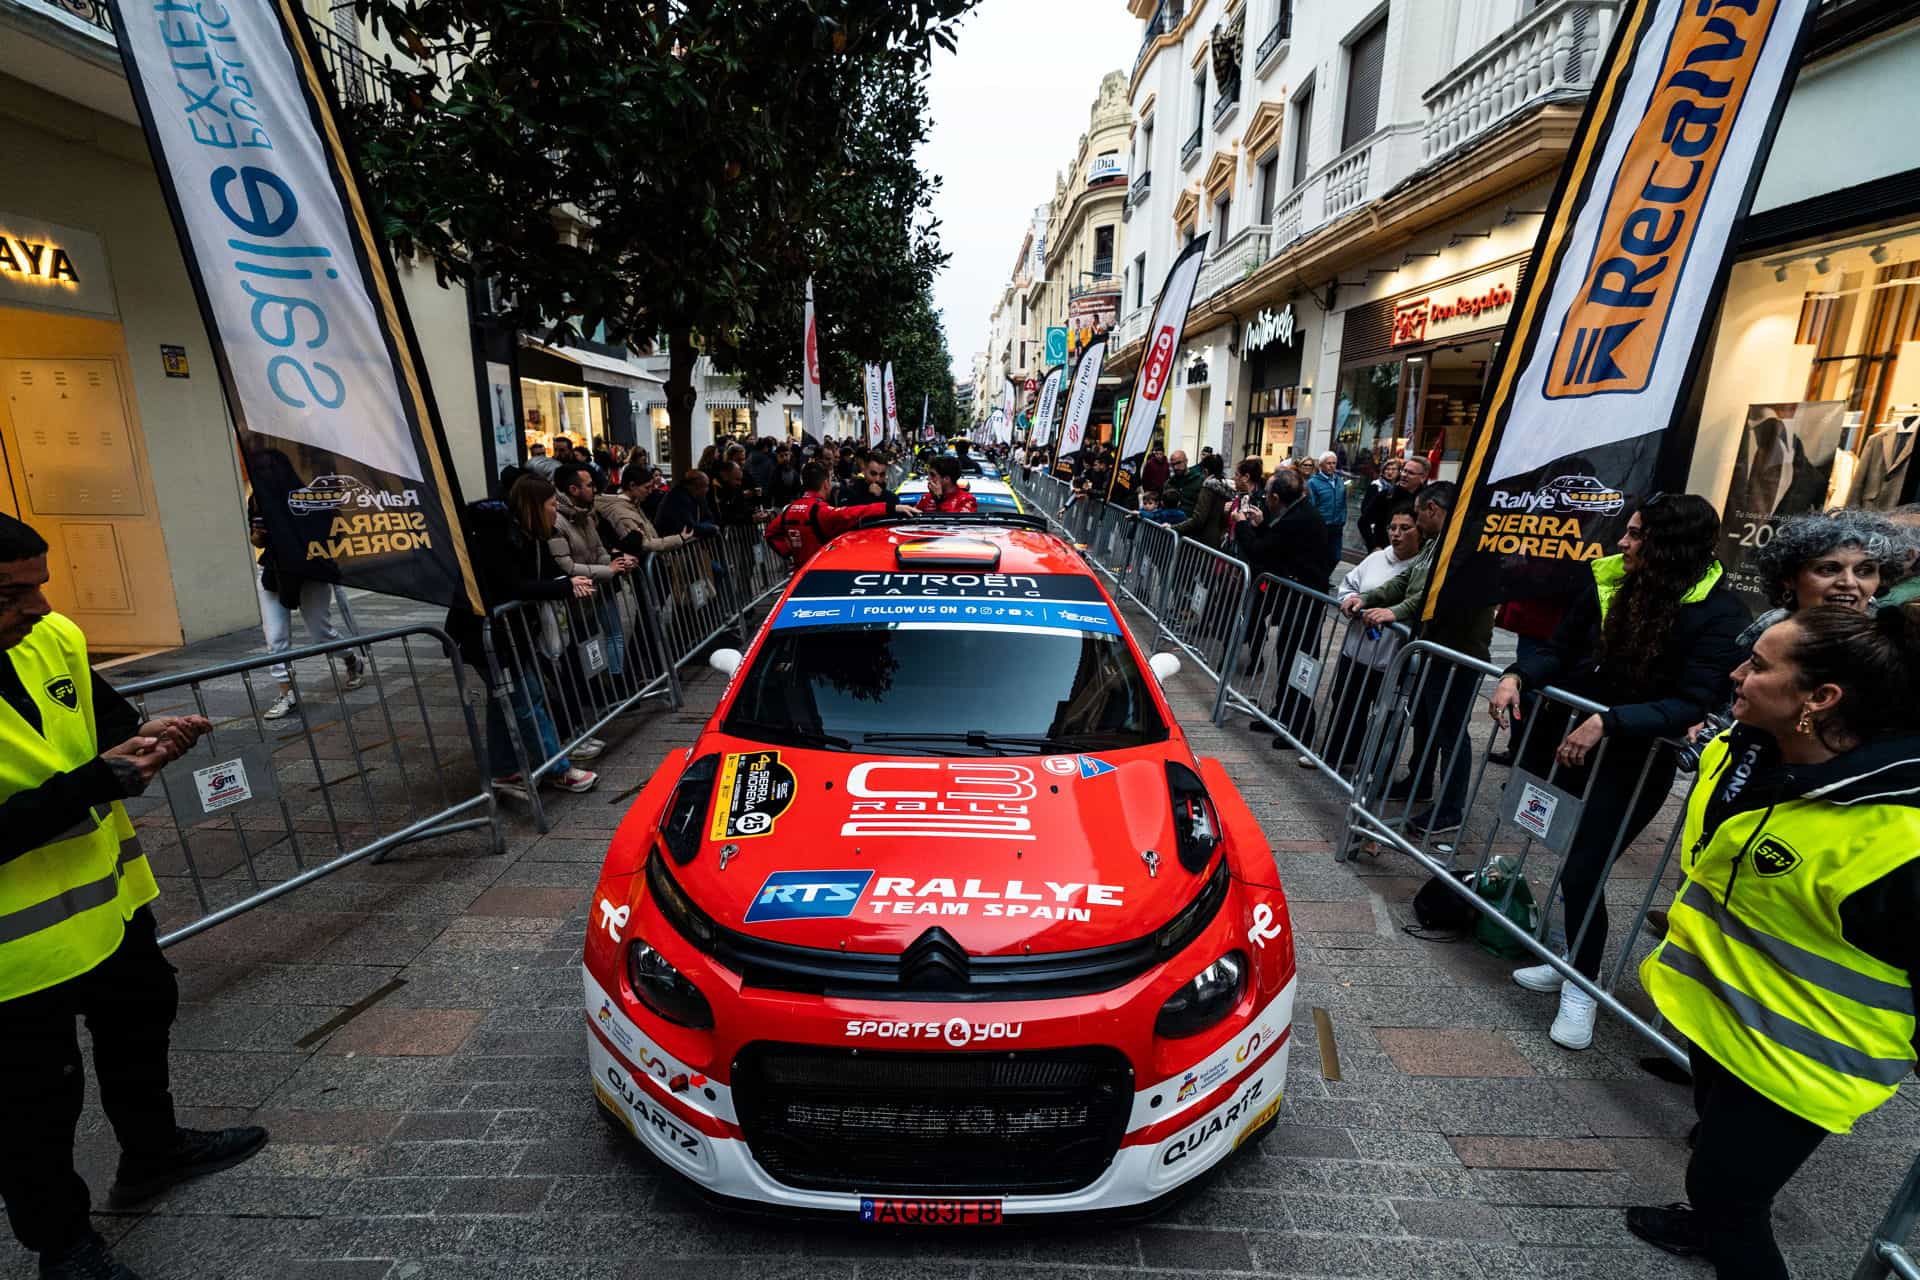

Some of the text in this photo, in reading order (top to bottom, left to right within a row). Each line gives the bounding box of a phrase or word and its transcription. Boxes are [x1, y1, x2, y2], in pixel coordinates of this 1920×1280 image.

[1490, 491, 1556, 513] Rallye
[1483, 514, 1582, 538] SIERRA
[1476, 534, 1604, 561] MORENA
[863, 606, 957, 614] FOLLOW US ON
[743, 771, 760, 813] MORENA
[757, 770, 770, 803] SIERRA
[846, 761, 1037, 801] C3
[743, 815, 764, 830] 25
[759, 883, 861, 904] RTS
[872, 877, 1125, 906] RALLYE
[869, 901, 1092, 922] TEAM SPAIN
[845, 1021, 941, 1038] SPORTS
[608, 1067, 699, 1157] QUARTZ
[1163, 1077, 1264, 1166] QUARTZ
[878, 1200, 998, 1223] AQ83FB
